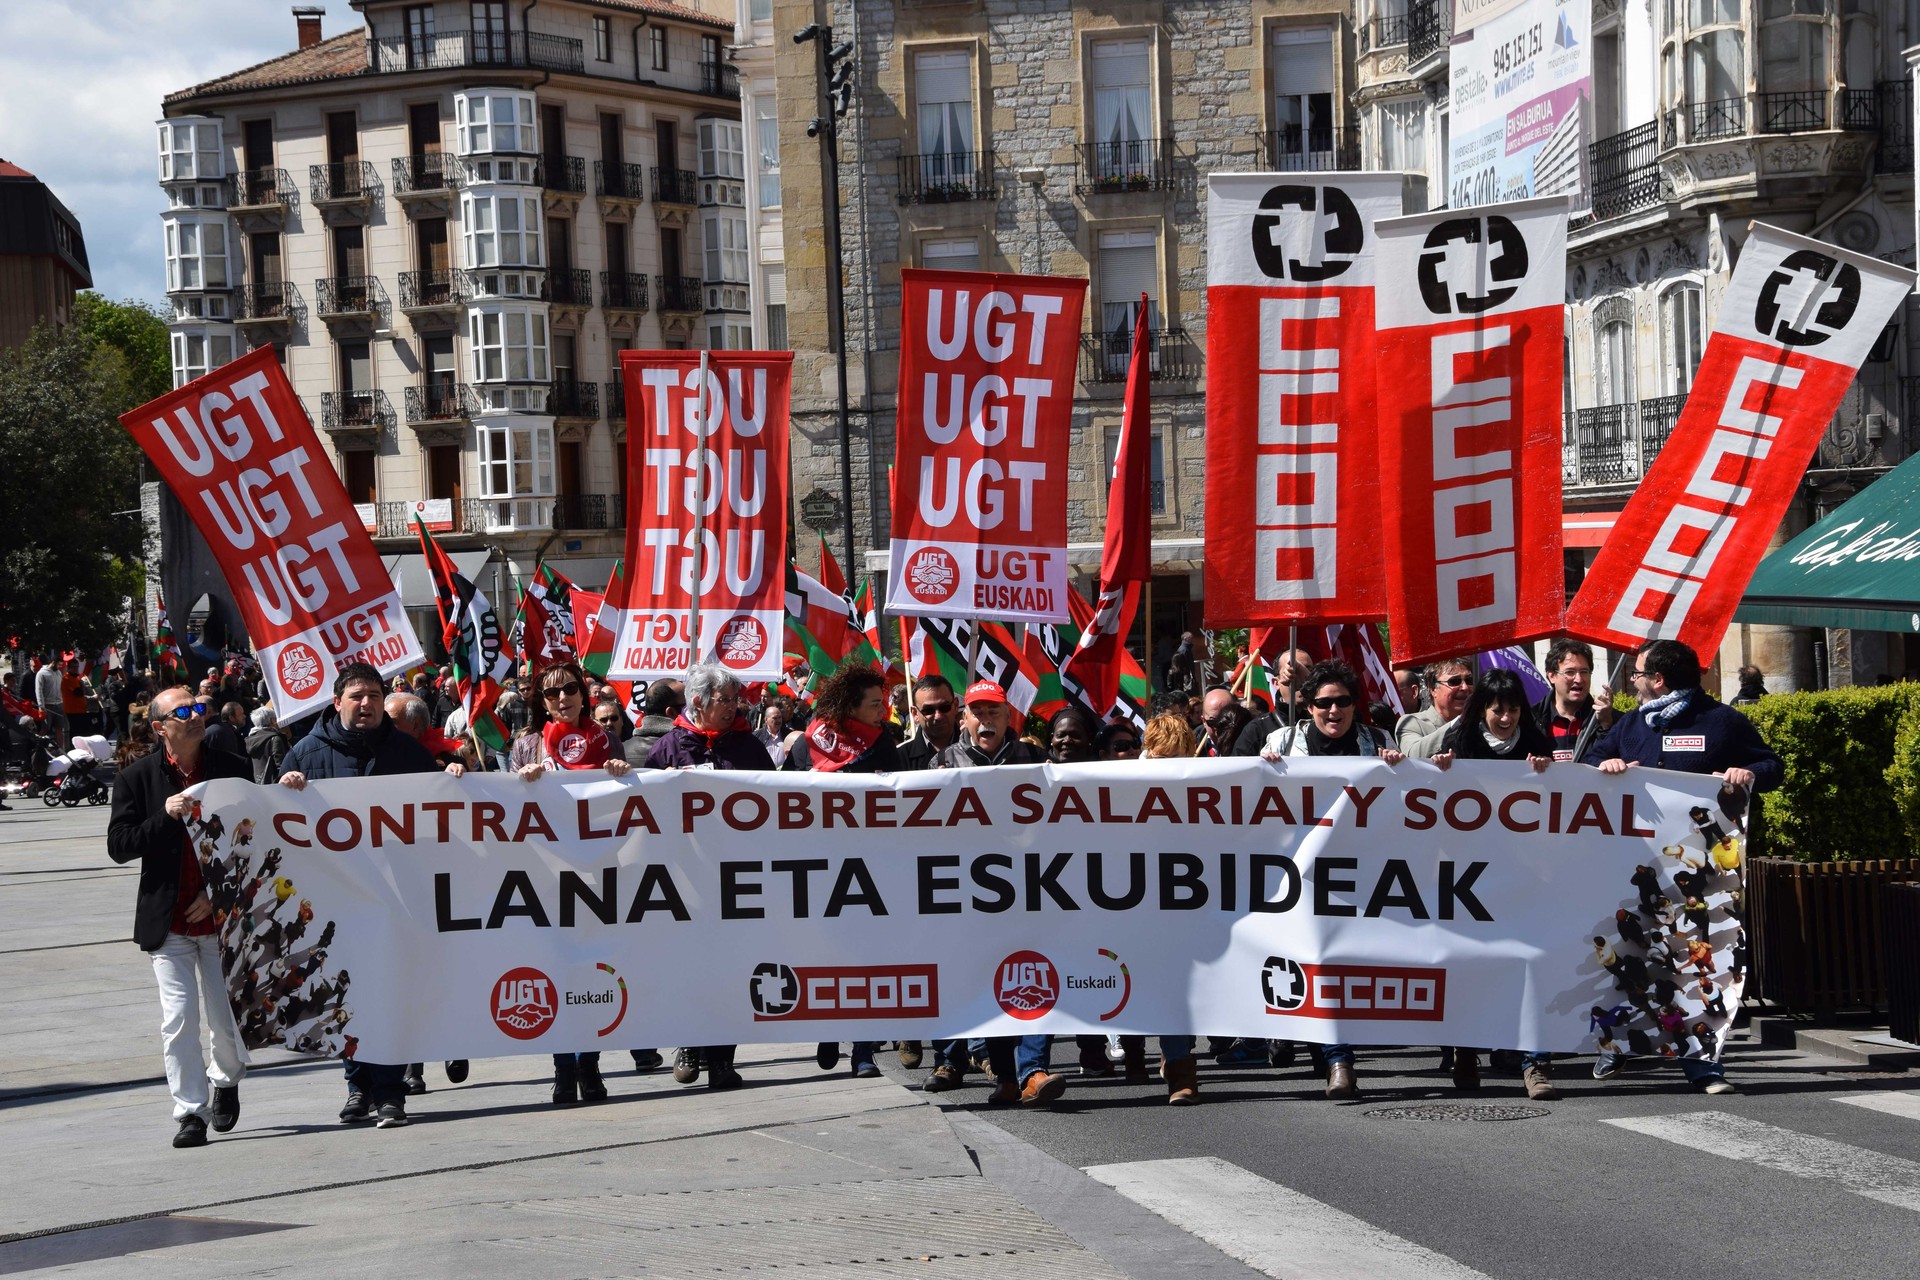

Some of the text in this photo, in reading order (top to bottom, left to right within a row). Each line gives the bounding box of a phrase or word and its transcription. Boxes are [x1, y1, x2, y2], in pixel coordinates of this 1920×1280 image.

[1493, 22, 1543, 78] 945 151 151
[1507, 99, 1553, 137] EN SALBURUA
[1543, 122, 1555, 136] ESTE
[1453, 165, 1495, 208] 145000
[926, 288, 1063, 365] UGT
[151, 370, 285, 478] UGT
[923, 372, 1053, 448] UGT
[1255, 297, 1340, 600] CCOO
[199, 445, 324, 550] UGT
[919, 455, 1046, 532] UGT
[1431, 324, 1516, 634] CCOO
[1607, 355, 1805, 640] CCOO
[241, 521, 360, 627] UGT
[917, 552, 948, 566] UGT
[975, 549, 1051, 582] UGT
[914, 588, 948, 596] EUSKADI
[974, 583, 1054, 612] EUSKADI
[319, 601, 391, 656] UGT
[282, 645, 307, 664] UGT
[291, 678, 319, 694] EUSKADI
[838, 742, 860, 756] Euskadi
[1675, 738, 1702, 746] CCOO
[273, 783, 1656, 852] CONTRA LA POBREZA SALARIAL Y SOCIAL
[434, 852, 1495, 933] LANA ETA ESKUBIDEAK
[500, 978, 548, 1005] UGT
[807, 975, 929, 1009] CCOO
[1002, 961, 1053, 989] UGT
[1066, 974, 1117, 990] Euskadi
[1313, 975, 1436, 1011] CCOO
[565, 989, 614, 1005] Euskadi
